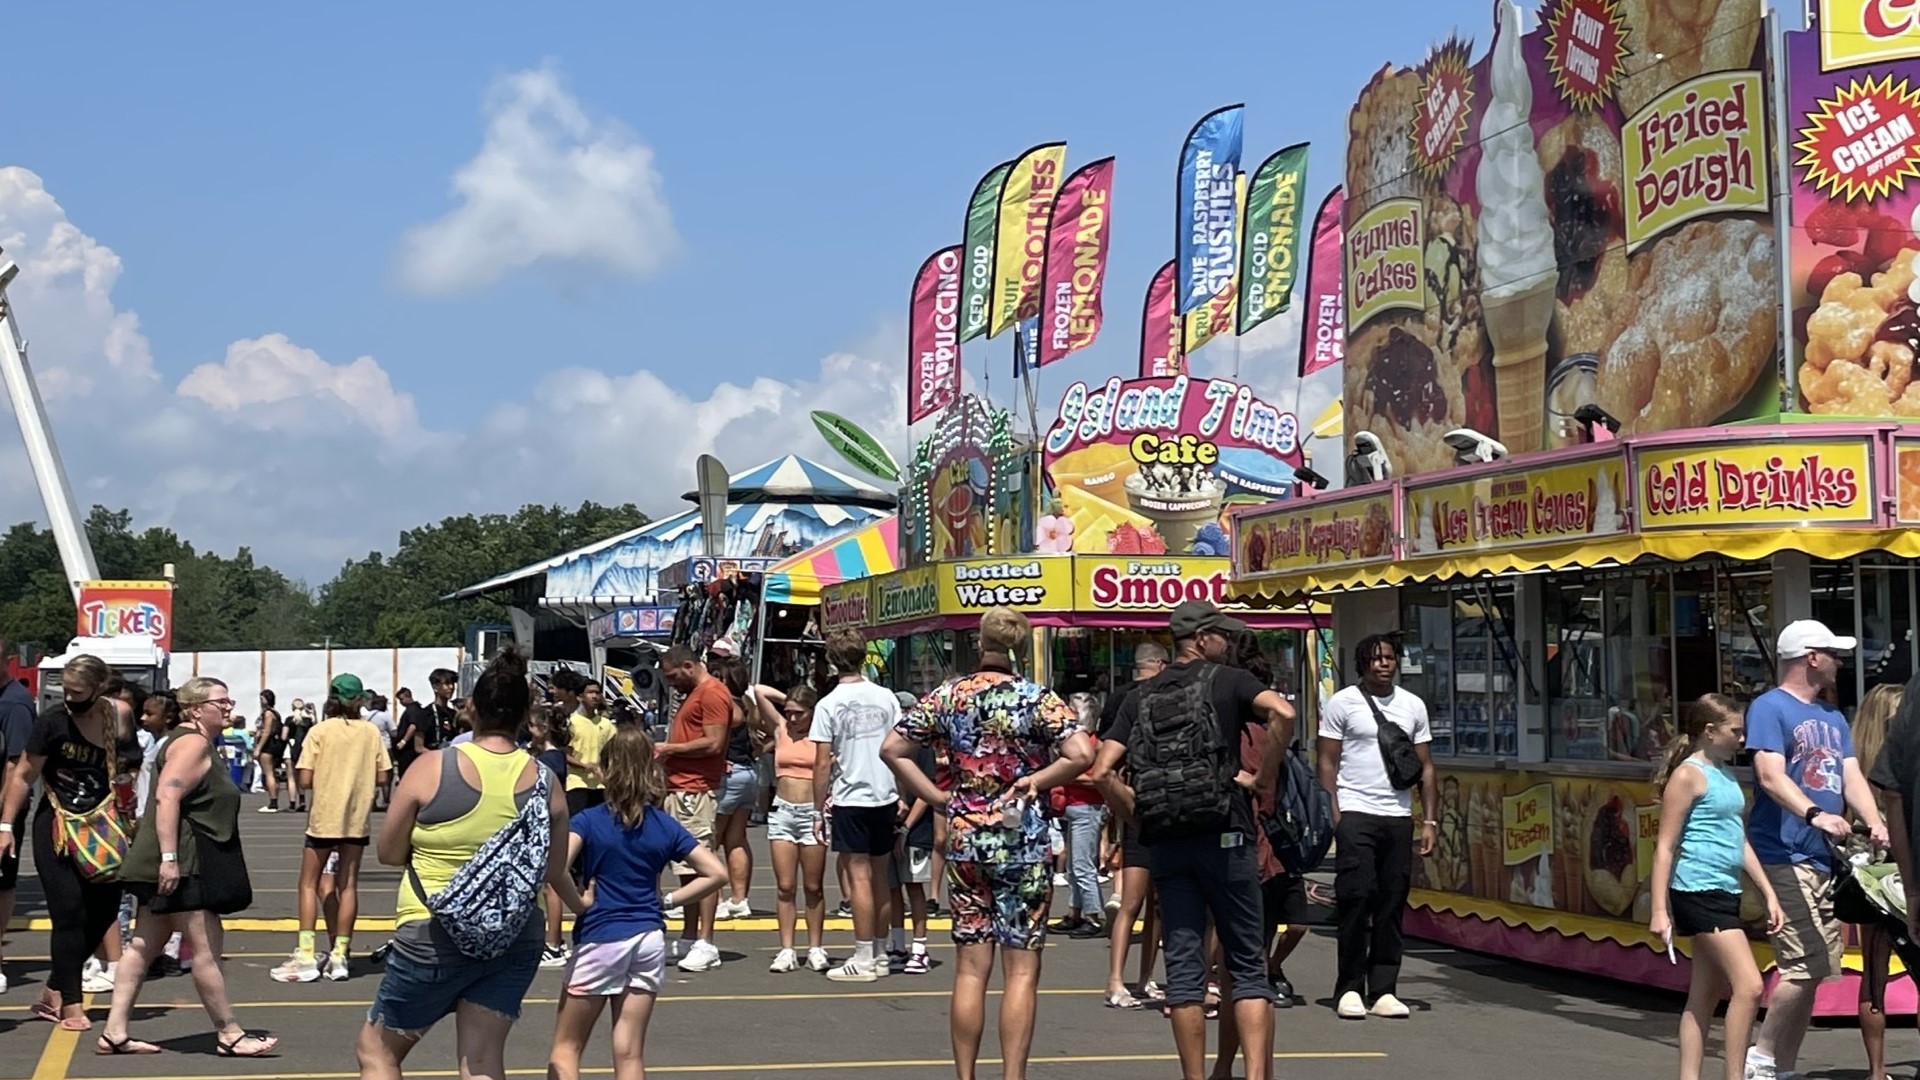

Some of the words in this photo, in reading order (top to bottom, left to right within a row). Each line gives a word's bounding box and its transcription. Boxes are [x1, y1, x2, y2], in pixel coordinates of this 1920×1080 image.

[1571, 7, 1605, 50] FRUIT
[1565, 39, 1600, 85] TOPPINGS
[1426, 78, 1446, 119] ICE
[1835, 97, 1881, 138] ICE
[1424, 86, 1460, 157] CREAM
[1637, 83, 1748, 171] Fried
[1831, 114, 1915, 175] CREAM
[1192, 149, 1212, 245] RASPBERRY
[1634, 137, 1756, 223] Dough
[1208, 162, 1234, 295] SLUSHIES
[1264, 170, 1299, 309] EMONADE
[1350, 208, 1420, 270] Funnel
[972, 245, 988, 289] COLD
[1069, 188, 1106, 352] LEMONADE
[1192, 256, 1208, 297] BLUE
[1252, 231, 1268, 278] COLD
[1248, 283, 1264, 320] ICED
[1354, 257, 1417, 309] Cakes
[934, 250, 958, 402] APPUCCINO
[968, 293, 984, 331] ICED
[1052, 281, 1072, 350] FROZEN
[1316, 294, 1337, 361] FROZEN
[1047, 374, 1188, 453] Island
[1200, 378, 1298, 454] Time
[1129, 433, 1219, 465] Cafe
[1083, 472, 1116, 486] MANGO
[1219, 470, 1239, 484] BLUE
[1239, 478, 1287, 495] RASPBERRY
[1646, 459, 1709, 514] Cold
[1716, 455, 1857, 510] Drinks
[1442, 501, 1468, 544] Ice
[1472, 495, 1529, 540] Cream
[1533, 485, 1586, 534] Cones
[954, 561, 1042, 582] Bottled
[1092, 566, 1233, 608] Smoot
[1127, 561, 1182, 576] Fruit
[878, 576, 936, 619] Lemonade
[955, 584, 1046, 607] Water
[84, 601, 165, 639] TICKETS
[1515, 799, 1537, 824] Ice
[1506, 823, 1550, 851] Cream
